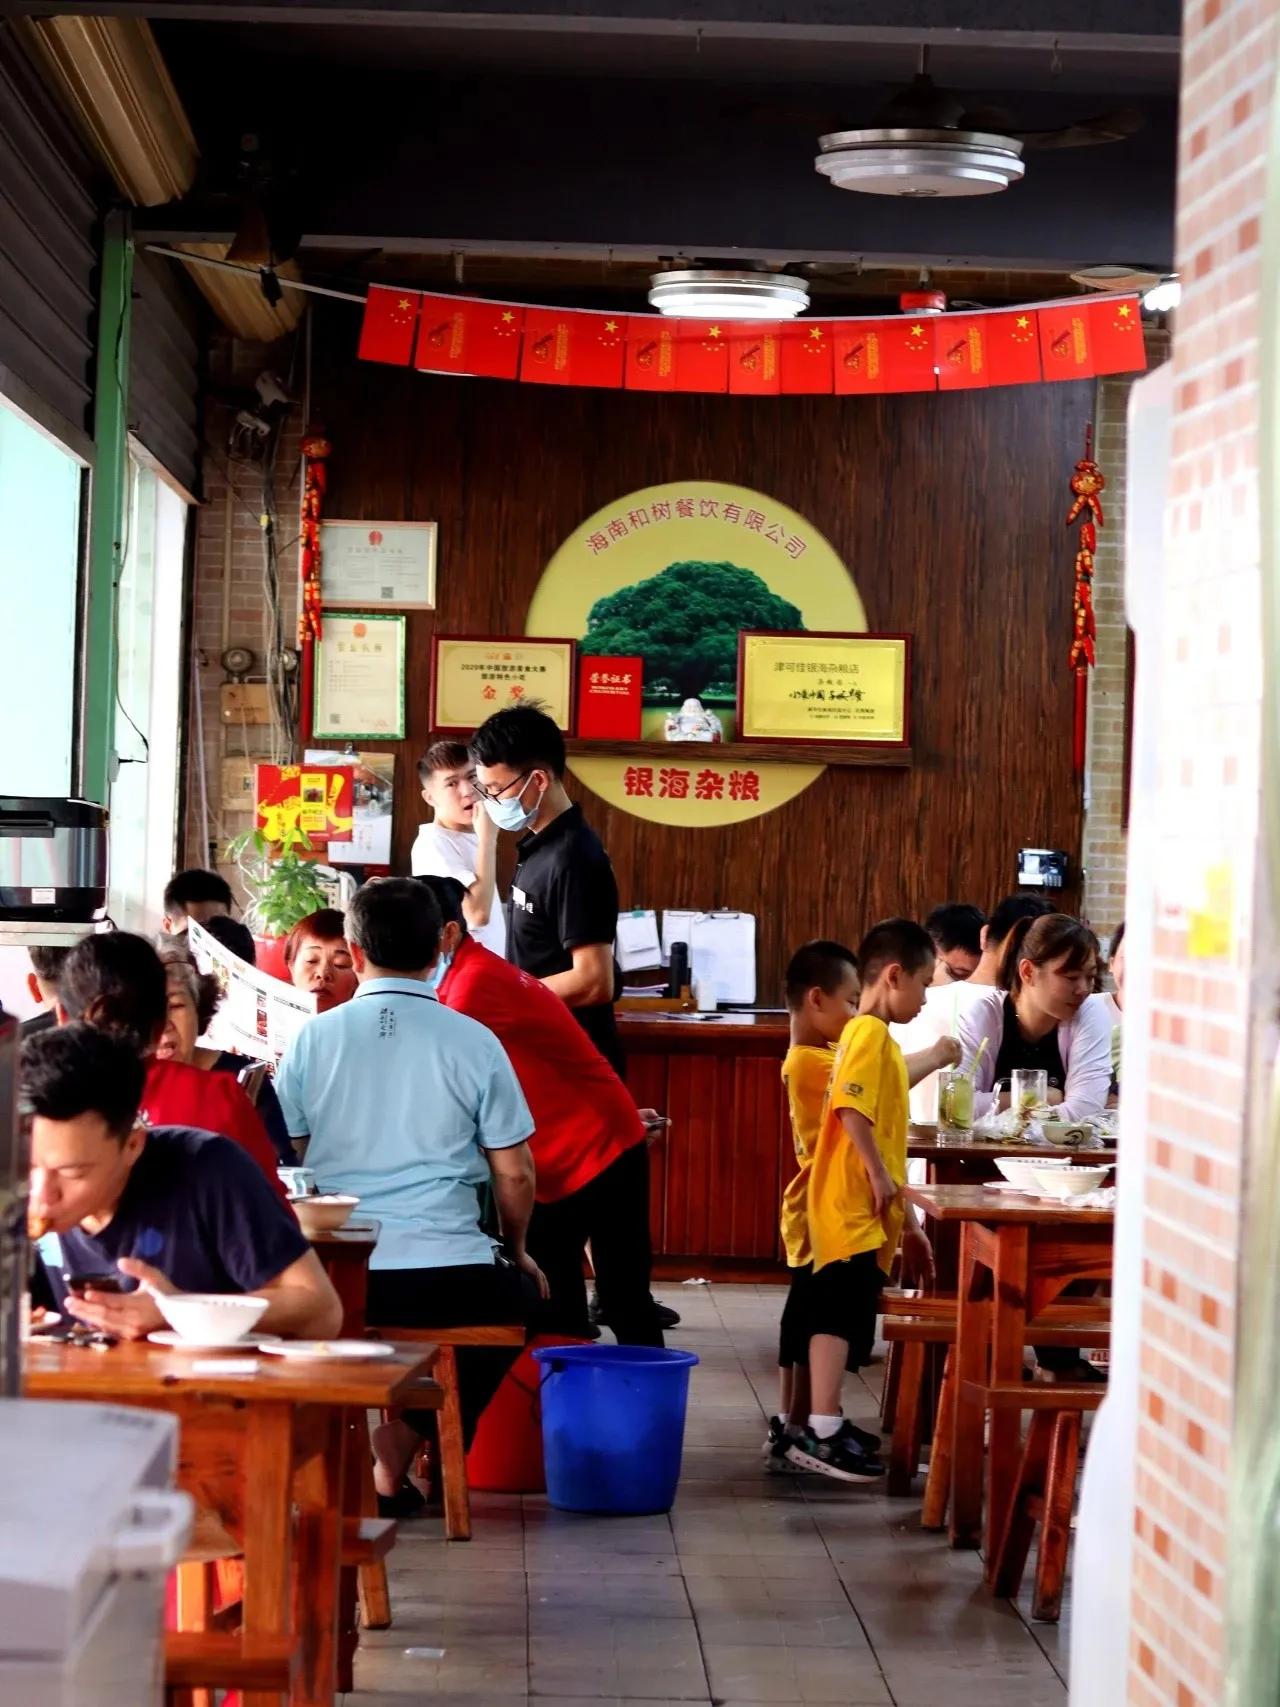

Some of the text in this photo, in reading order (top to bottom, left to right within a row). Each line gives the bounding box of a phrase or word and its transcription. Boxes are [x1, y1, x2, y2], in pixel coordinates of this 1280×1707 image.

[585, 498, 808, 560] 海南和树餐饮有限公司
[482, 684, 525, 702] 金奖
[624, 766, 760, 801] 银海杂粮
